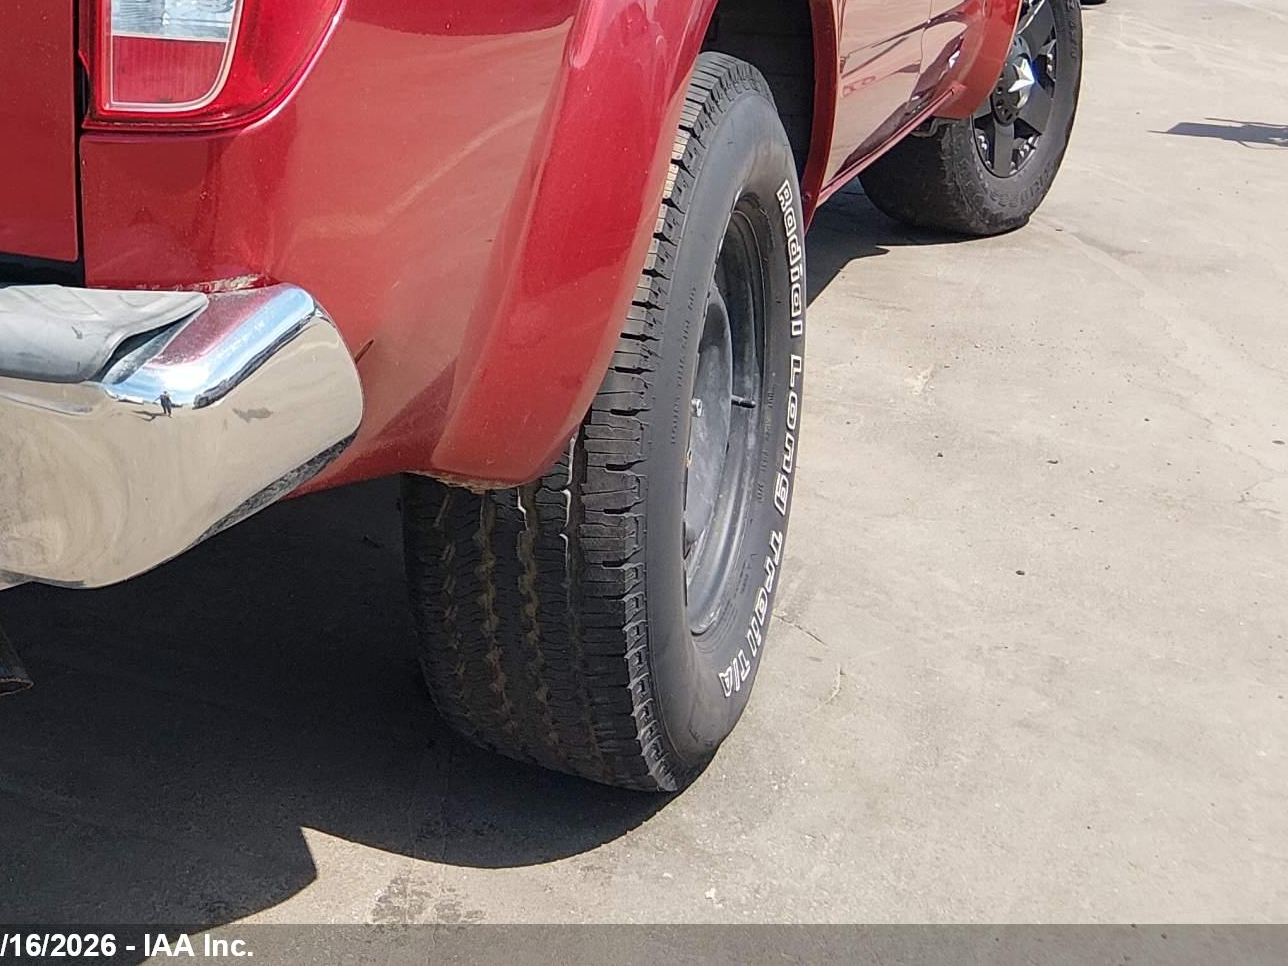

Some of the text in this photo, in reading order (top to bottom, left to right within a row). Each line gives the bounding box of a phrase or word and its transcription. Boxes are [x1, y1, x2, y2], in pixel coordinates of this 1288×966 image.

[776, 178, 804, 337] Radial
[773, 353, 803, 516] Long
[745, 530, 784, 658] Trail
[717, 649, 752, 698] T/A
